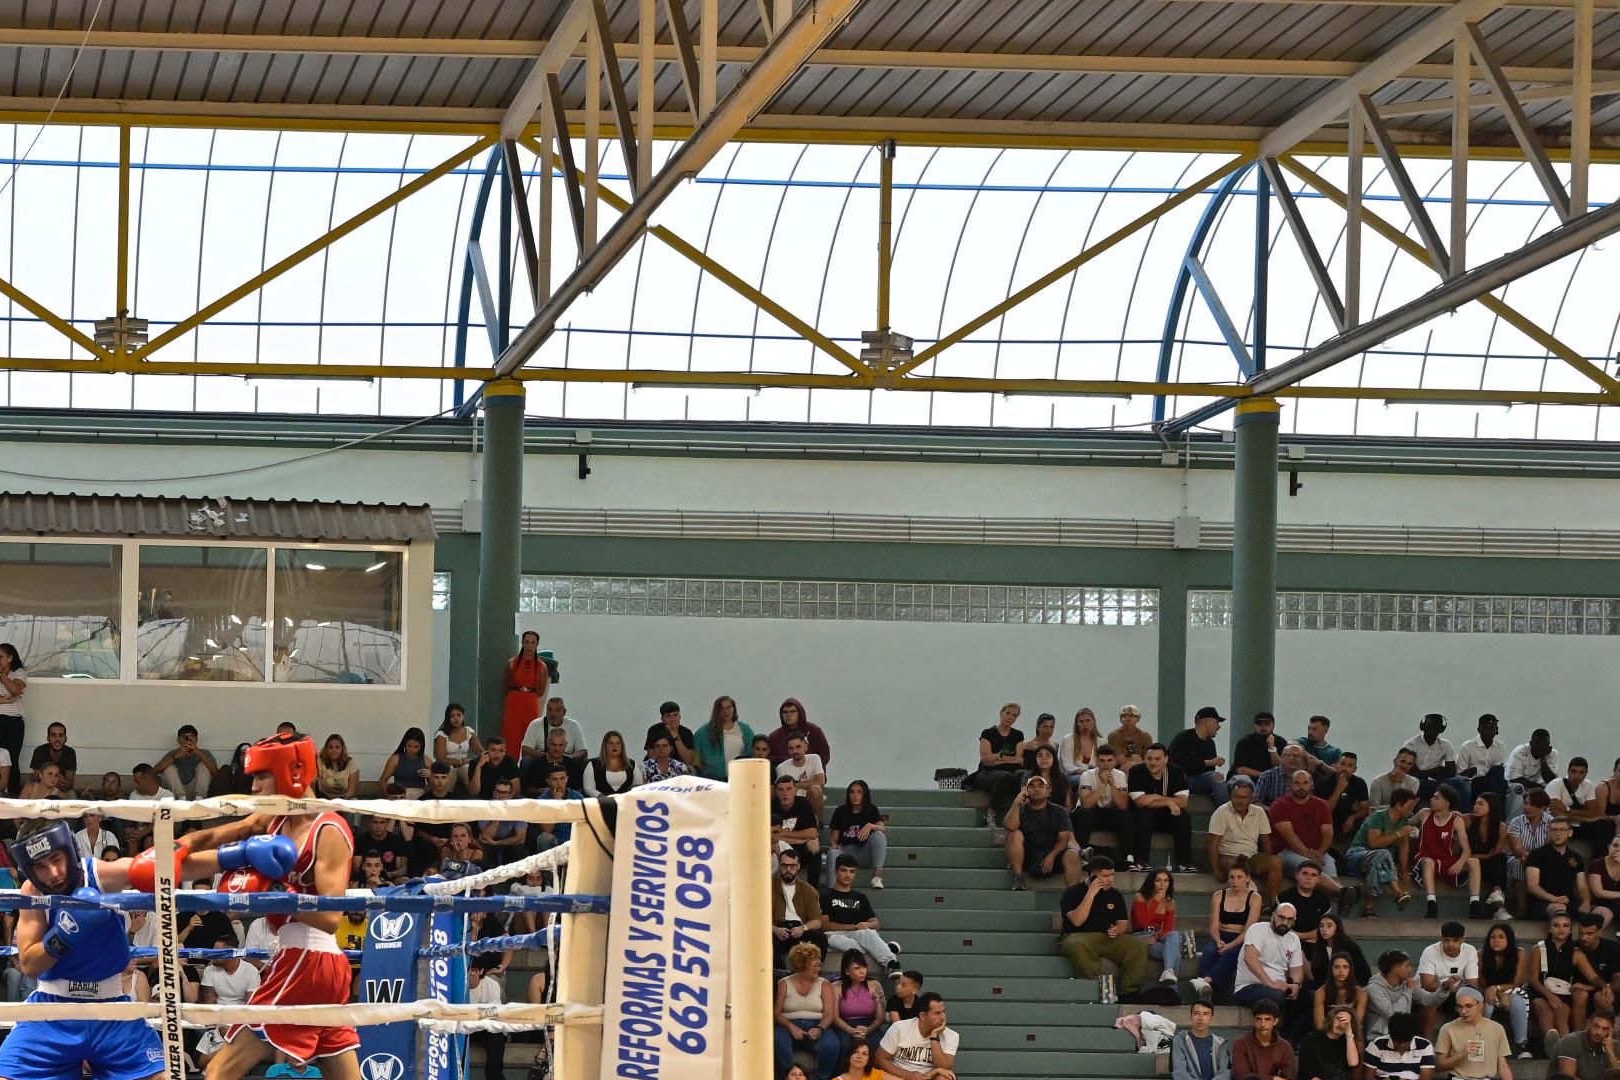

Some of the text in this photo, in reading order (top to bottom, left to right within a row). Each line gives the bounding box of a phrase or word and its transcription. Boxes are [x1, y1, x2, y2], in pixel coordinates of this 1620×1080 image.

[630, 799, 670, 926] SERVICIOS
[160, 877, 173, 988] INTERCANARIAS
[375, 941, 402, 949] WINNER
[628, 925, 663, 942] Y
[667, 835, 714, 1055] 662 571 058
[165, 990, 178, 1042] BOXING
